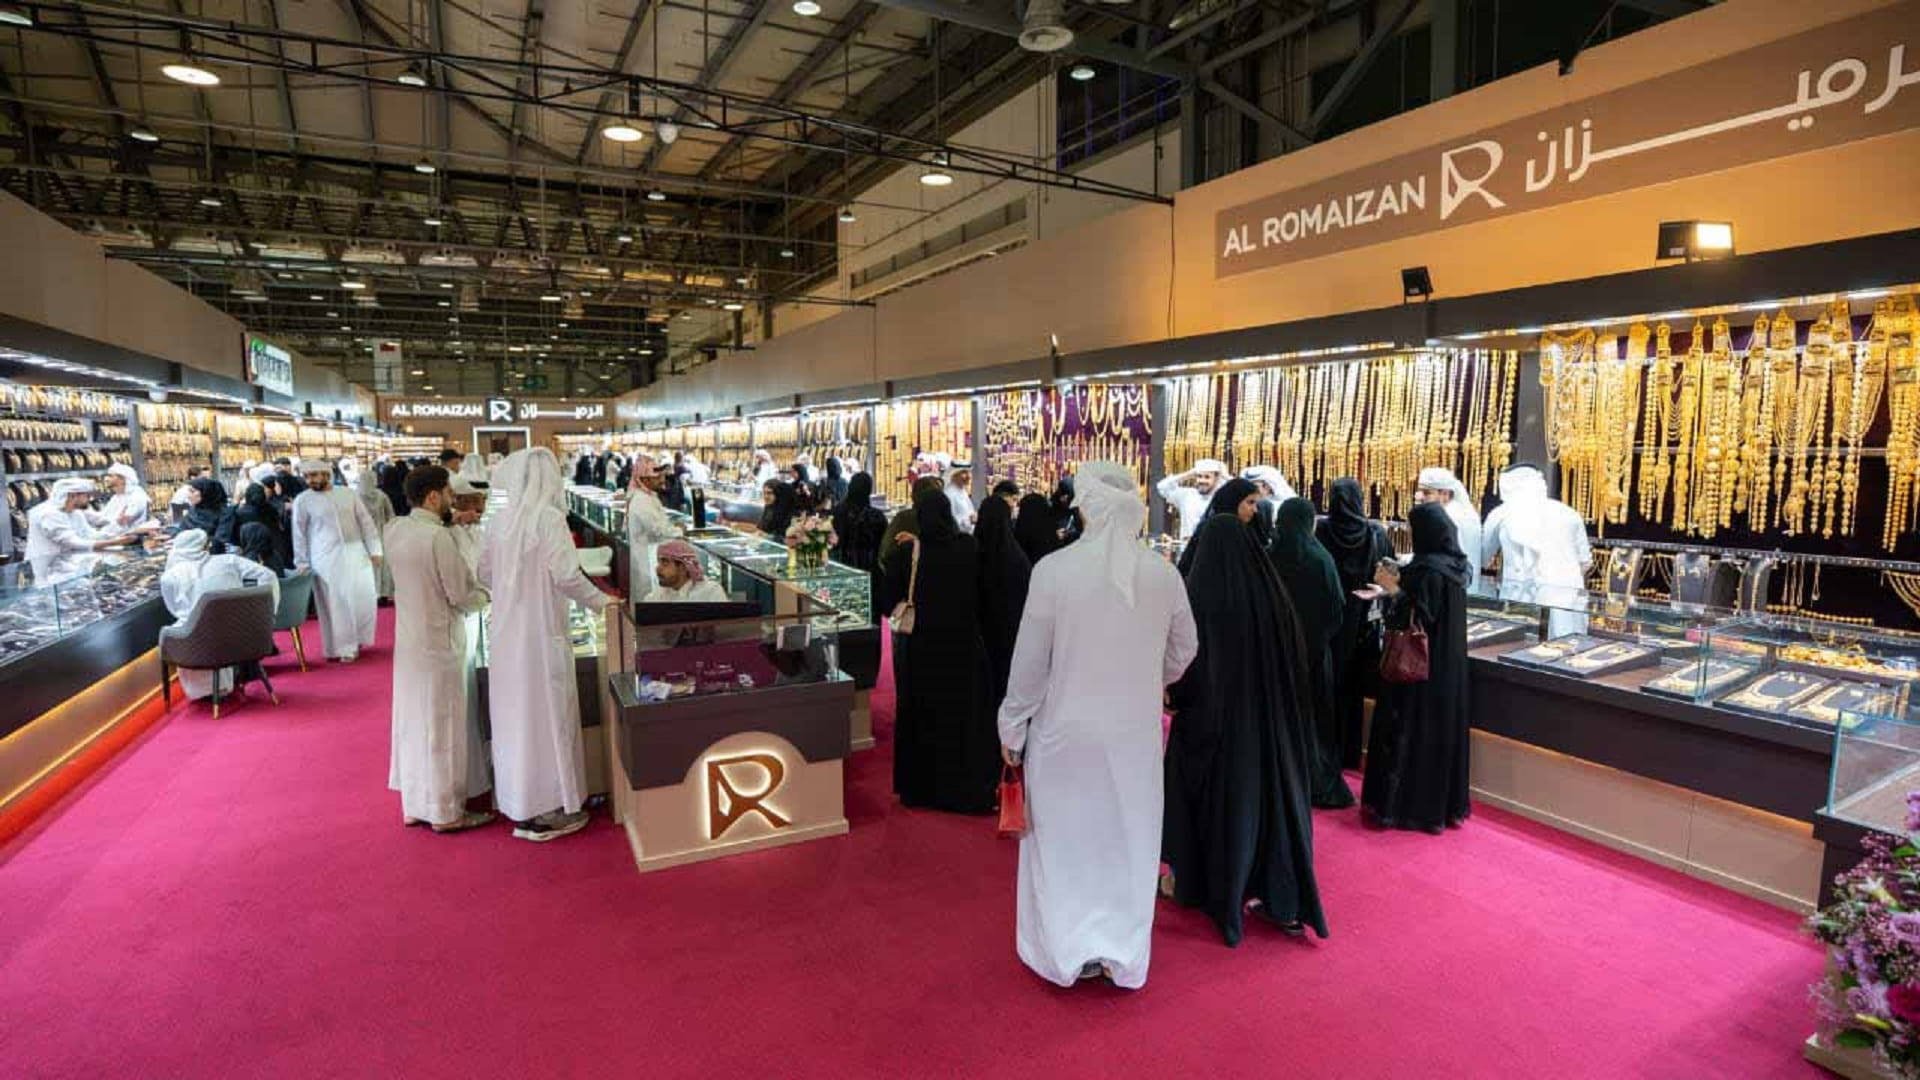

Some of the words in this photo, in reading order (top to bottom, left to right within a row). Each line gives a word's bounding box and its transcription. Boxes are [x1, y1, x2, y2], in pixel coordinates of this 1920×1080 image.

[1223, 227, 1256, 257] AL
[1262, 176, 1427, 247] ROMAIZAN
[391, 404, 412, 417] AL
[412, 404, 483, 417] ROMAIZAN
